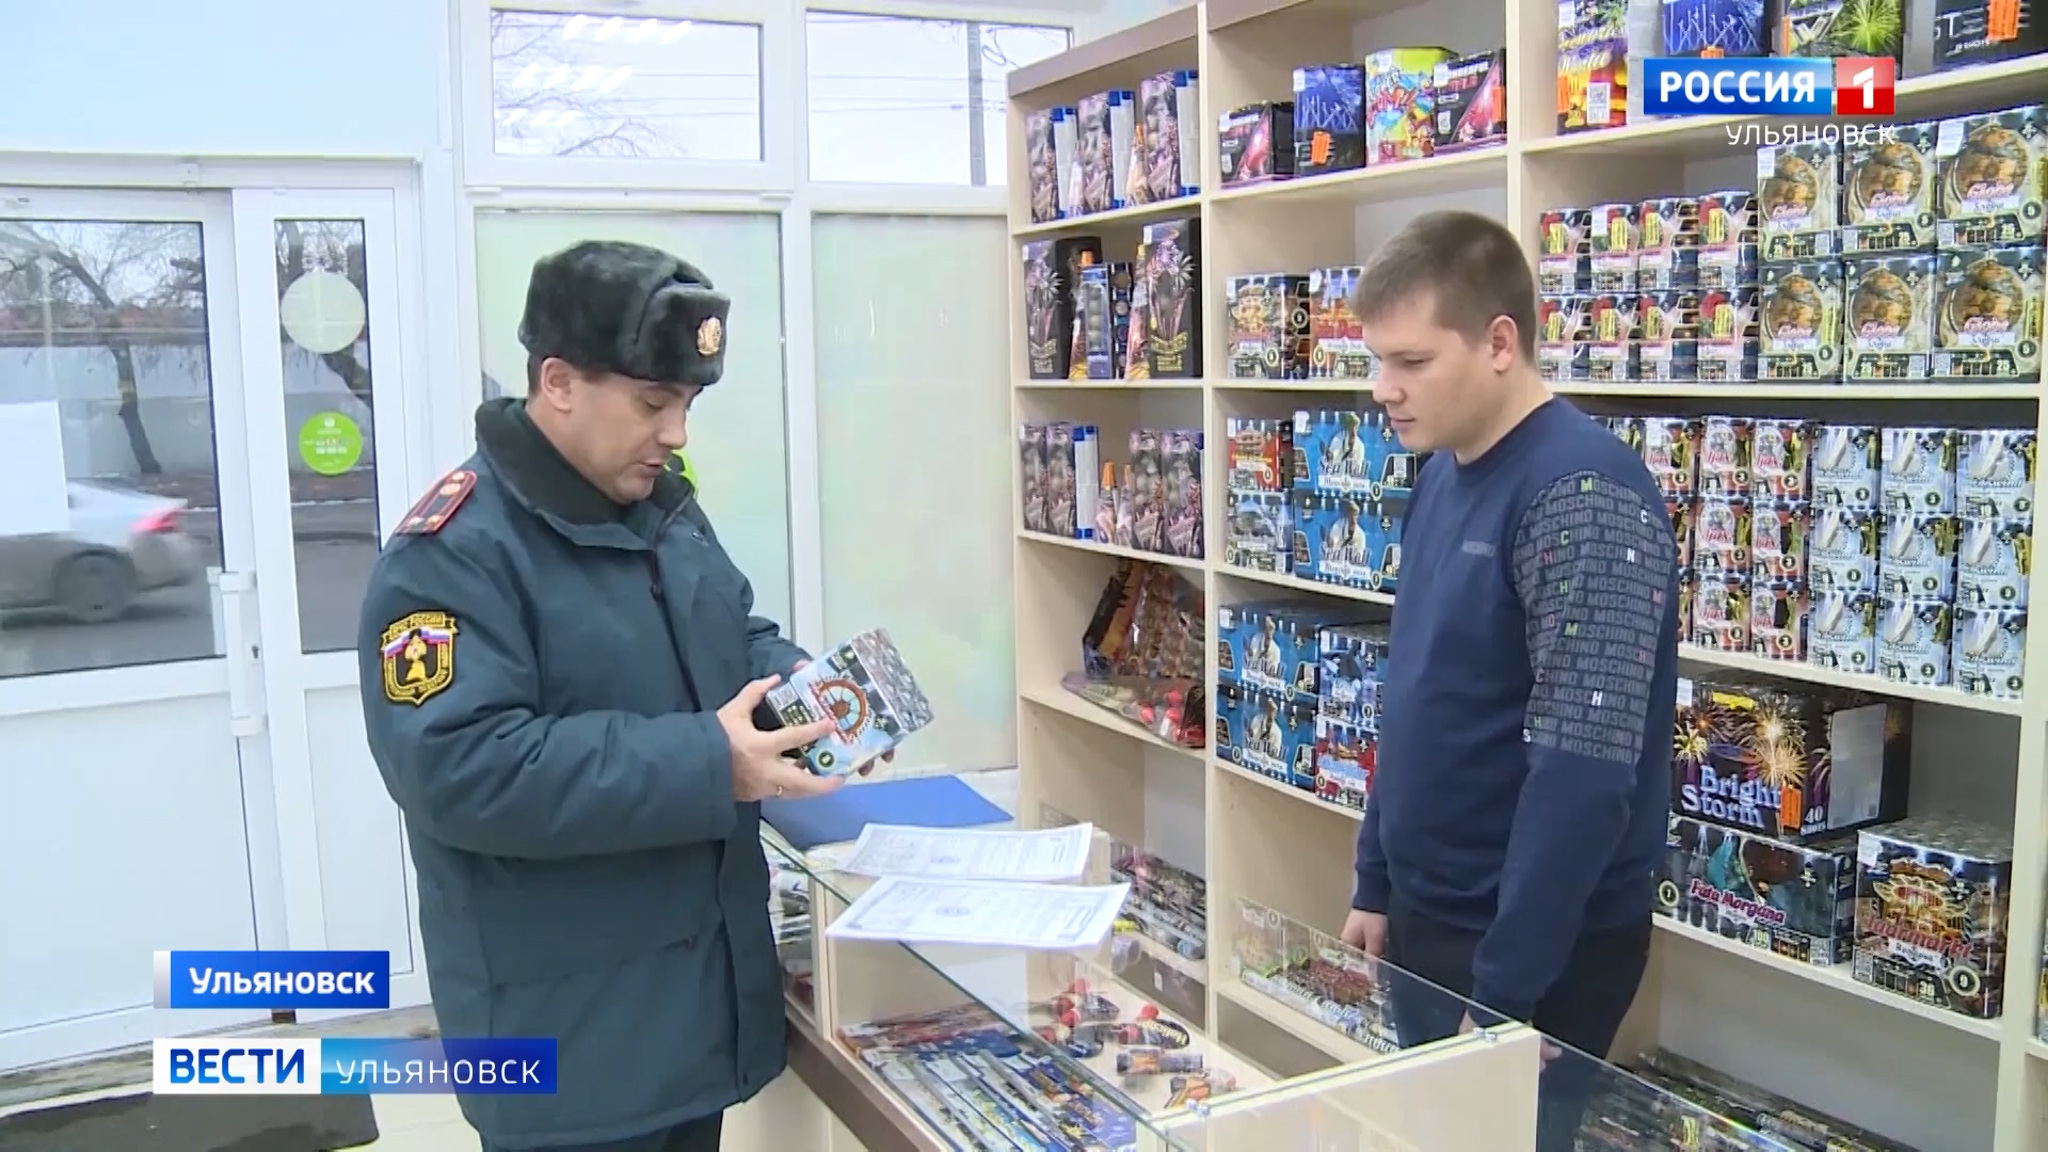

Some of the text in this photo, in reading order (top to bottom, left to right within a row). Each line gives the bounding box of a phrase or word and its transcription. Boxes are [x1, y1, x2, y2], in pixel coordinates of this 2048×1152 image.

[1546, 496, 1614, 516] MOSCHINO
[1587, 576, 1650, 599] MOSCHINO
[1587, 592, 1650, 615] MOSCHINO
[1564, 622, 1636, 645] MOSCHINO
[1594, 609, 1656, 634] MOSCHINO
[1576, 655, 1645, 681] MOSCHINO
[1553, 686, 1627, 711] MOSCHINO
[1561, 719, 1633, 747] MOSCHINO
[1560, 737, 1632, 765] MOSCHINO
[1700, 765, 1782, 809] Bright
[1681, 784, 1765, 829] Storm
[1805, 806, 1824, 823] 40
[1721, 889, 1786, 926] Morgana
